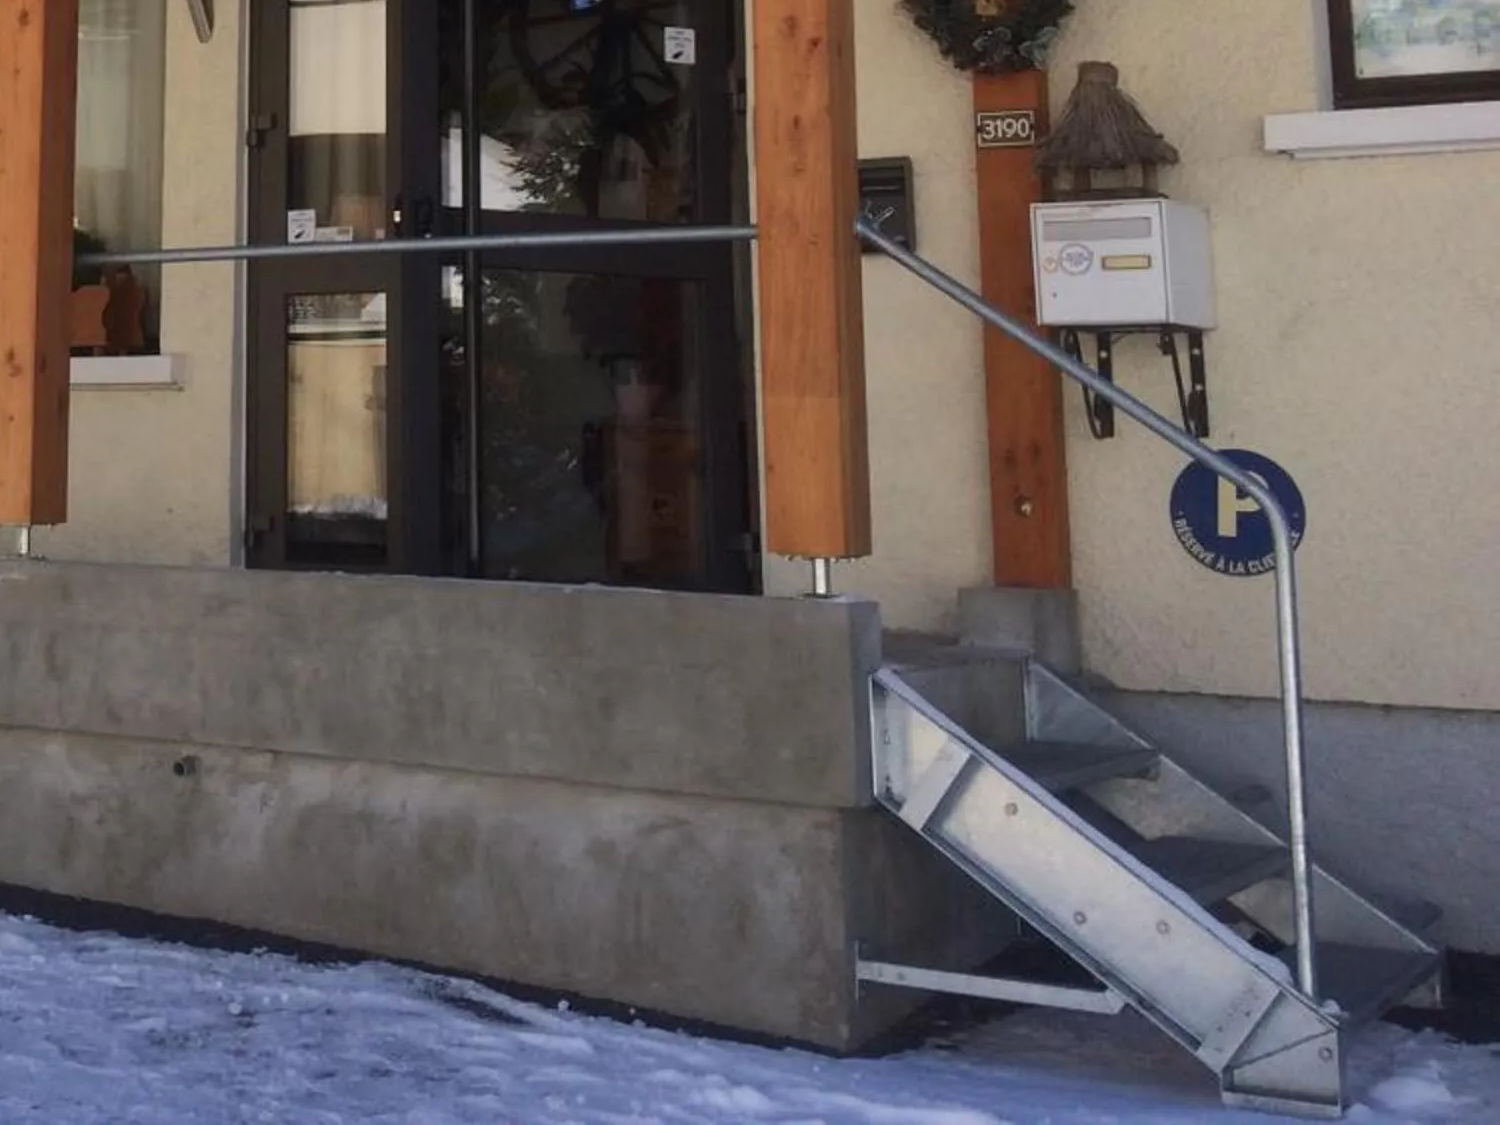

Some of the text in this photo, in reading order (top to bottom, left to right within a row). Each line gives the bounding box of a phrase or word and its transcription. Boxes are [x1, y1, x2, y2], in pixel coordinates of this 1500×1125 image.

[981, 118, 1030, 140] 3190
[1216, 470, 1271, 538] P
[1229, 558, 1247, 574] LA
